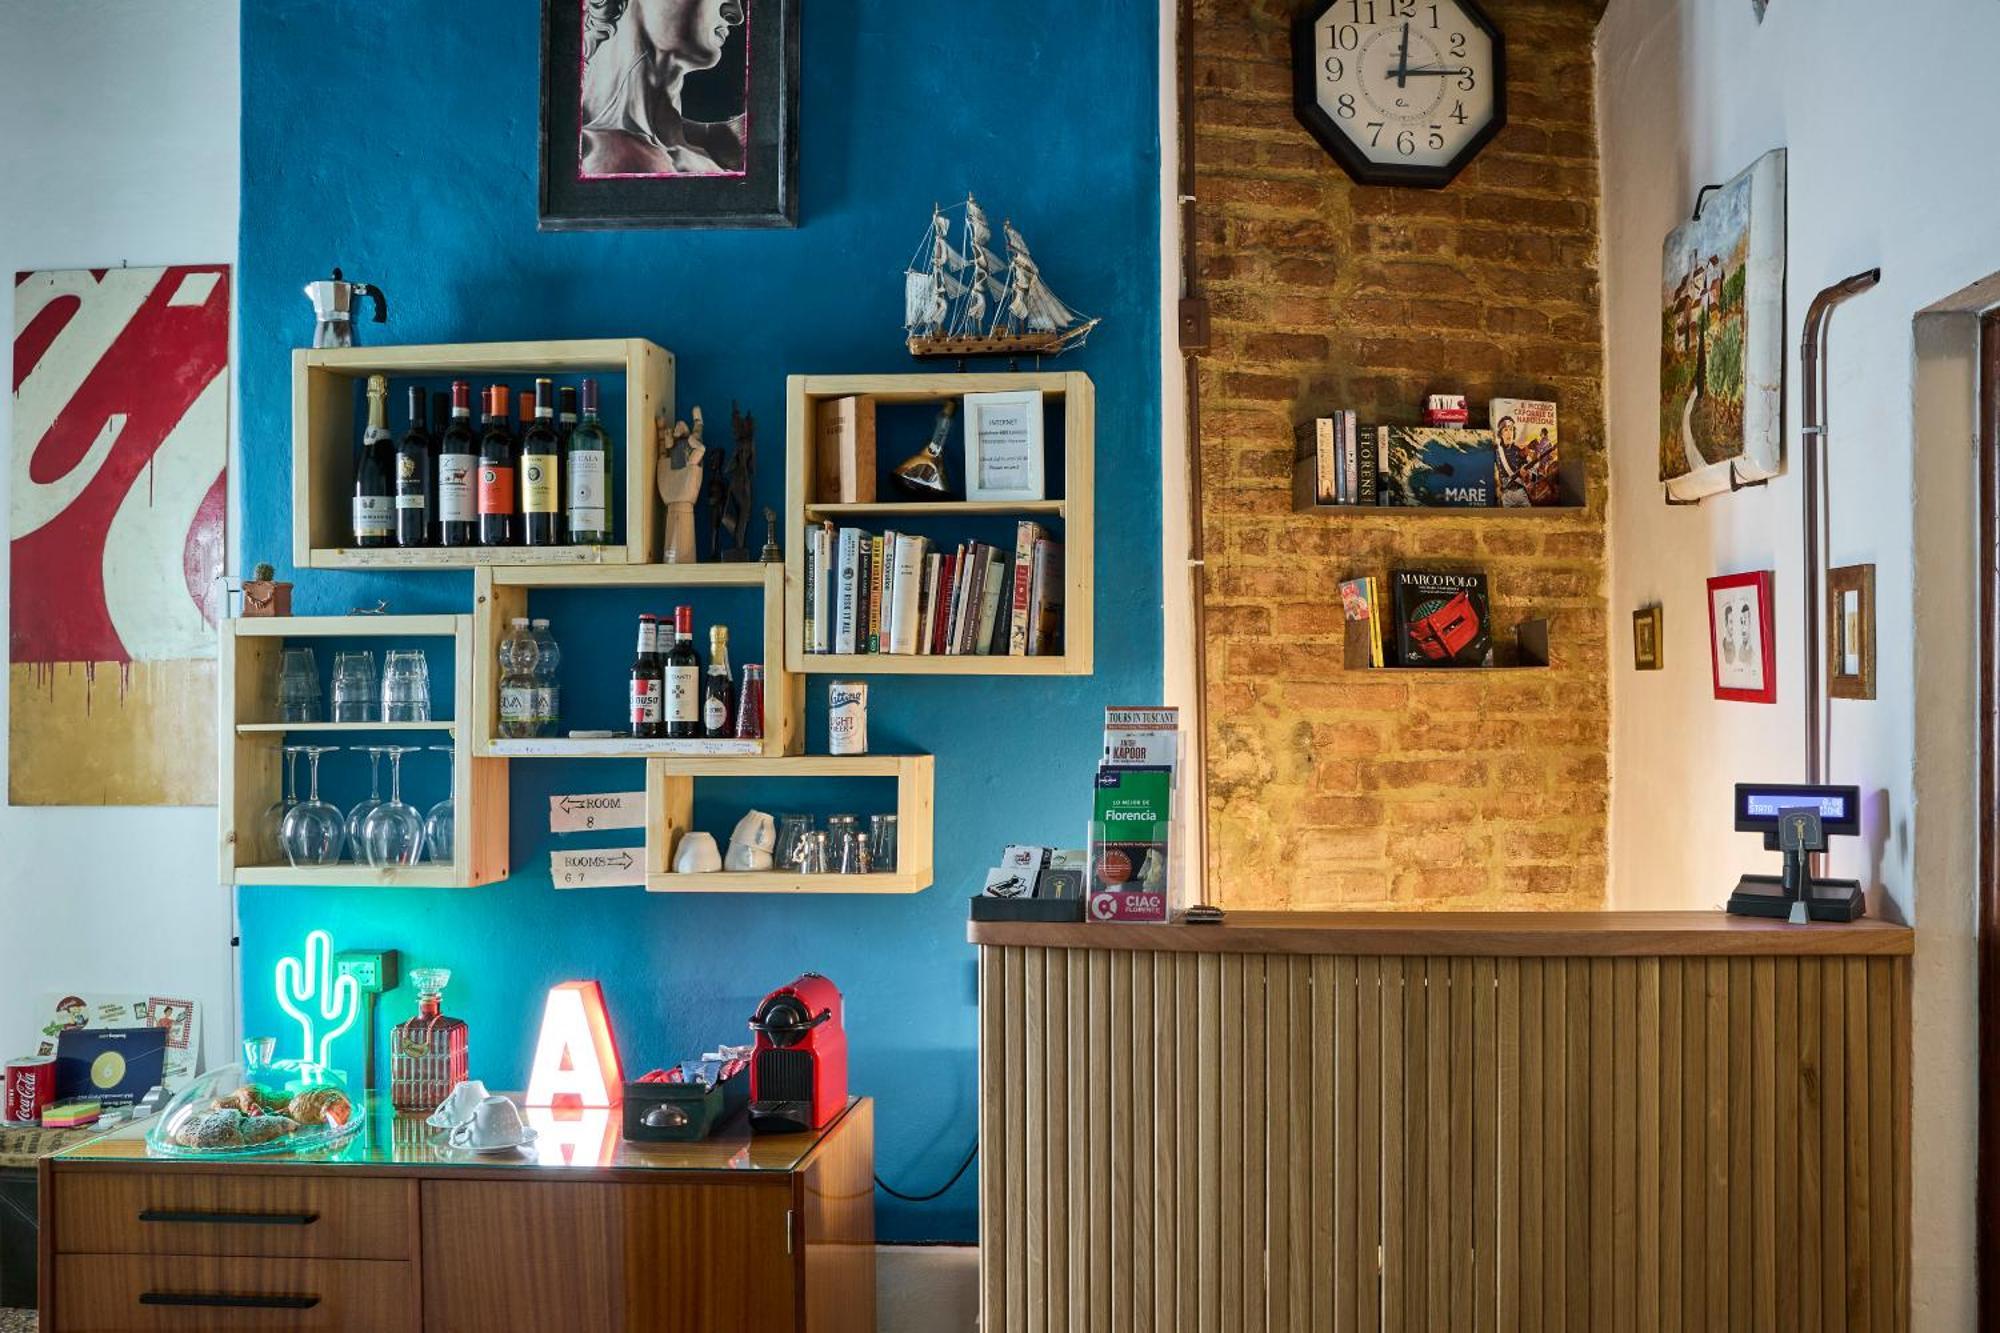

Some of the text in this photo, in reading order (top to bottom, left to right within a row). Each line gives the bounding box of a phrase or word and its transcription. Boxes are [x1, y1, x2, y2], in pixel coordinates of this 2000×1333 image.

[1351, 0, 1377, 25] 11
[1388, 0, 1417, 18] 12
[1426, 4, 1441, 29] 1
[1325, 24, 1359, 51] 10
[1449, 32, 1467, 58] 2
[1324, 56, 1344, 82] 9
[1457, 66, 1476, 92] 3
[1337, 93, 1356, 119] 8
[1449, 99, 1469, 125] 4
[1366, 121, 1385, 148] 7
[1396, 130, 1416, 157] 6
[1428, 124, 1444, 150] 5
[1360, 431, 1371, 496] FLORENS
[1400, 573, 1478, 587] MARCO POLO
[1109, 712, 1132, 723] TOURS
[1142, 712, 1174, 723] TUSCANY
[1112, 746, 1147, 760] KAPOOR
[585, 798, 621, 809] ROOM
[1105, 809, 1157, 821] Florencia
[586, 816, 595, 829] 8
[564, 856, 606, 867] ROOMS
[564, 872, 572, 882] 6
[526, 979, 625, 1108] A
